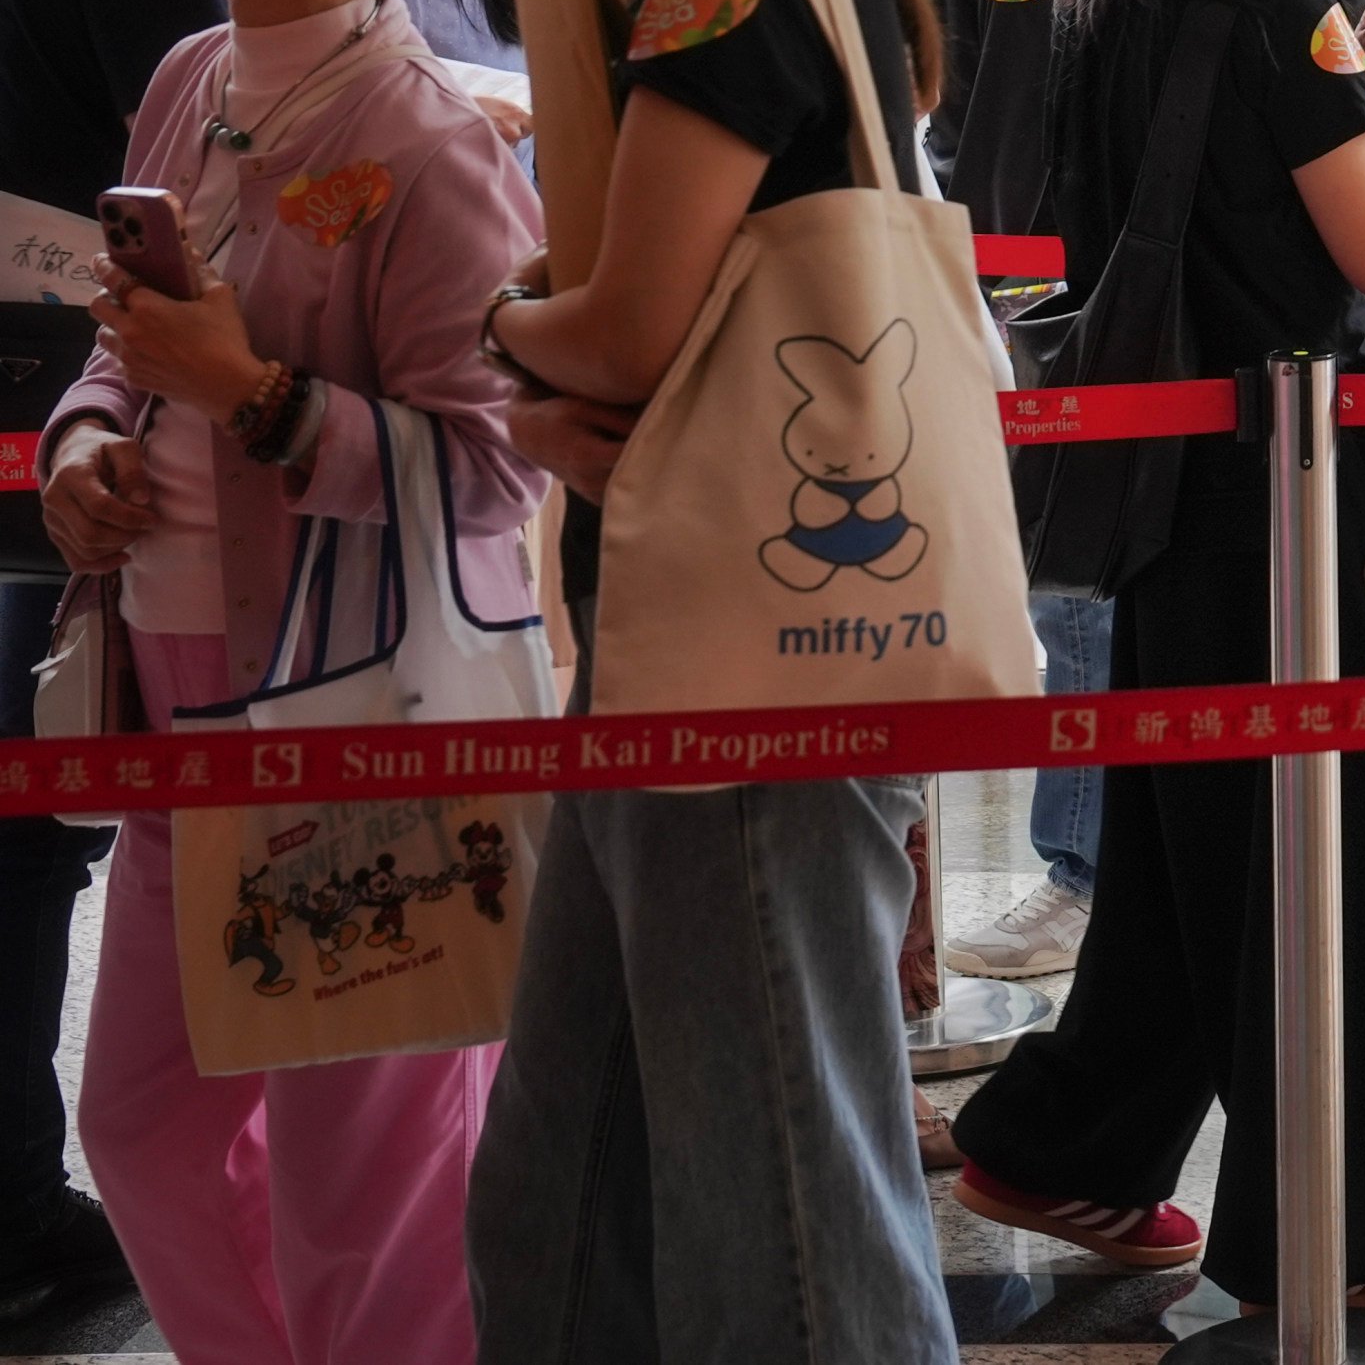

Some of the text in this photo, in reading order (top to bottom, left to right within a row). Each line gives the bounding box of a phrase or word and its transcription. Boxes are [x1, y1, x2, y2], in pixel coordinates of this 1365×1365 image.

[1005, 416, 1082, 438] Properties
[779, 610, 947, 661] miffy 70
[341, 741, 424, 781] Sun
[443, 737, 561, 781] Hung
[579, 728, 653, 770] Kai
[670, 718, 889, 771] Properties
[313, 977, 358, 1002] Where
[360, 968, 383, 985] the
